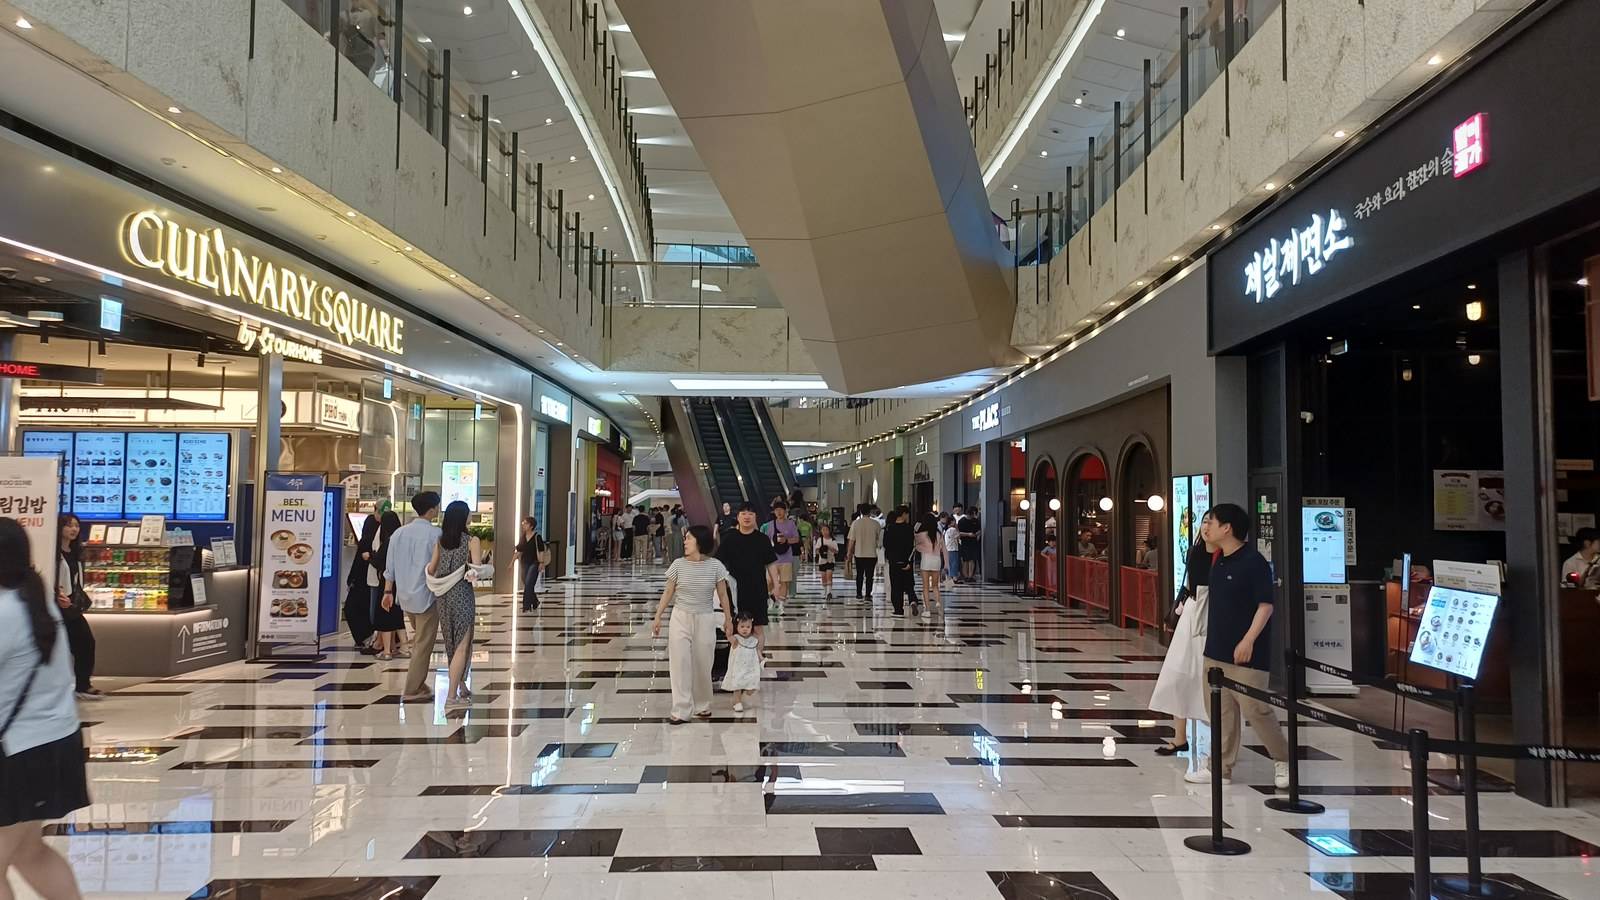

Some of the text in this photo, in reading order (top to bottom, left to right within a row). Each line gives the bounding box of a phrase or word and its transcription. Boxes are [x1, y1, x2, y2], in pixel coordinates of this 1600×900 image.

[1353, 192, 1382, 220] 국수와
[1405, 156, 1440, 191] 한잔의
[121, 209, 404, 355] CULINARY SQUARE
[1244, 208, 1354, 304] 제일제면소
[237, 321, 323, 365] by OURHOME
[271, 509, 316, 522] MENU
[283, 498, 305, 506] BEST
